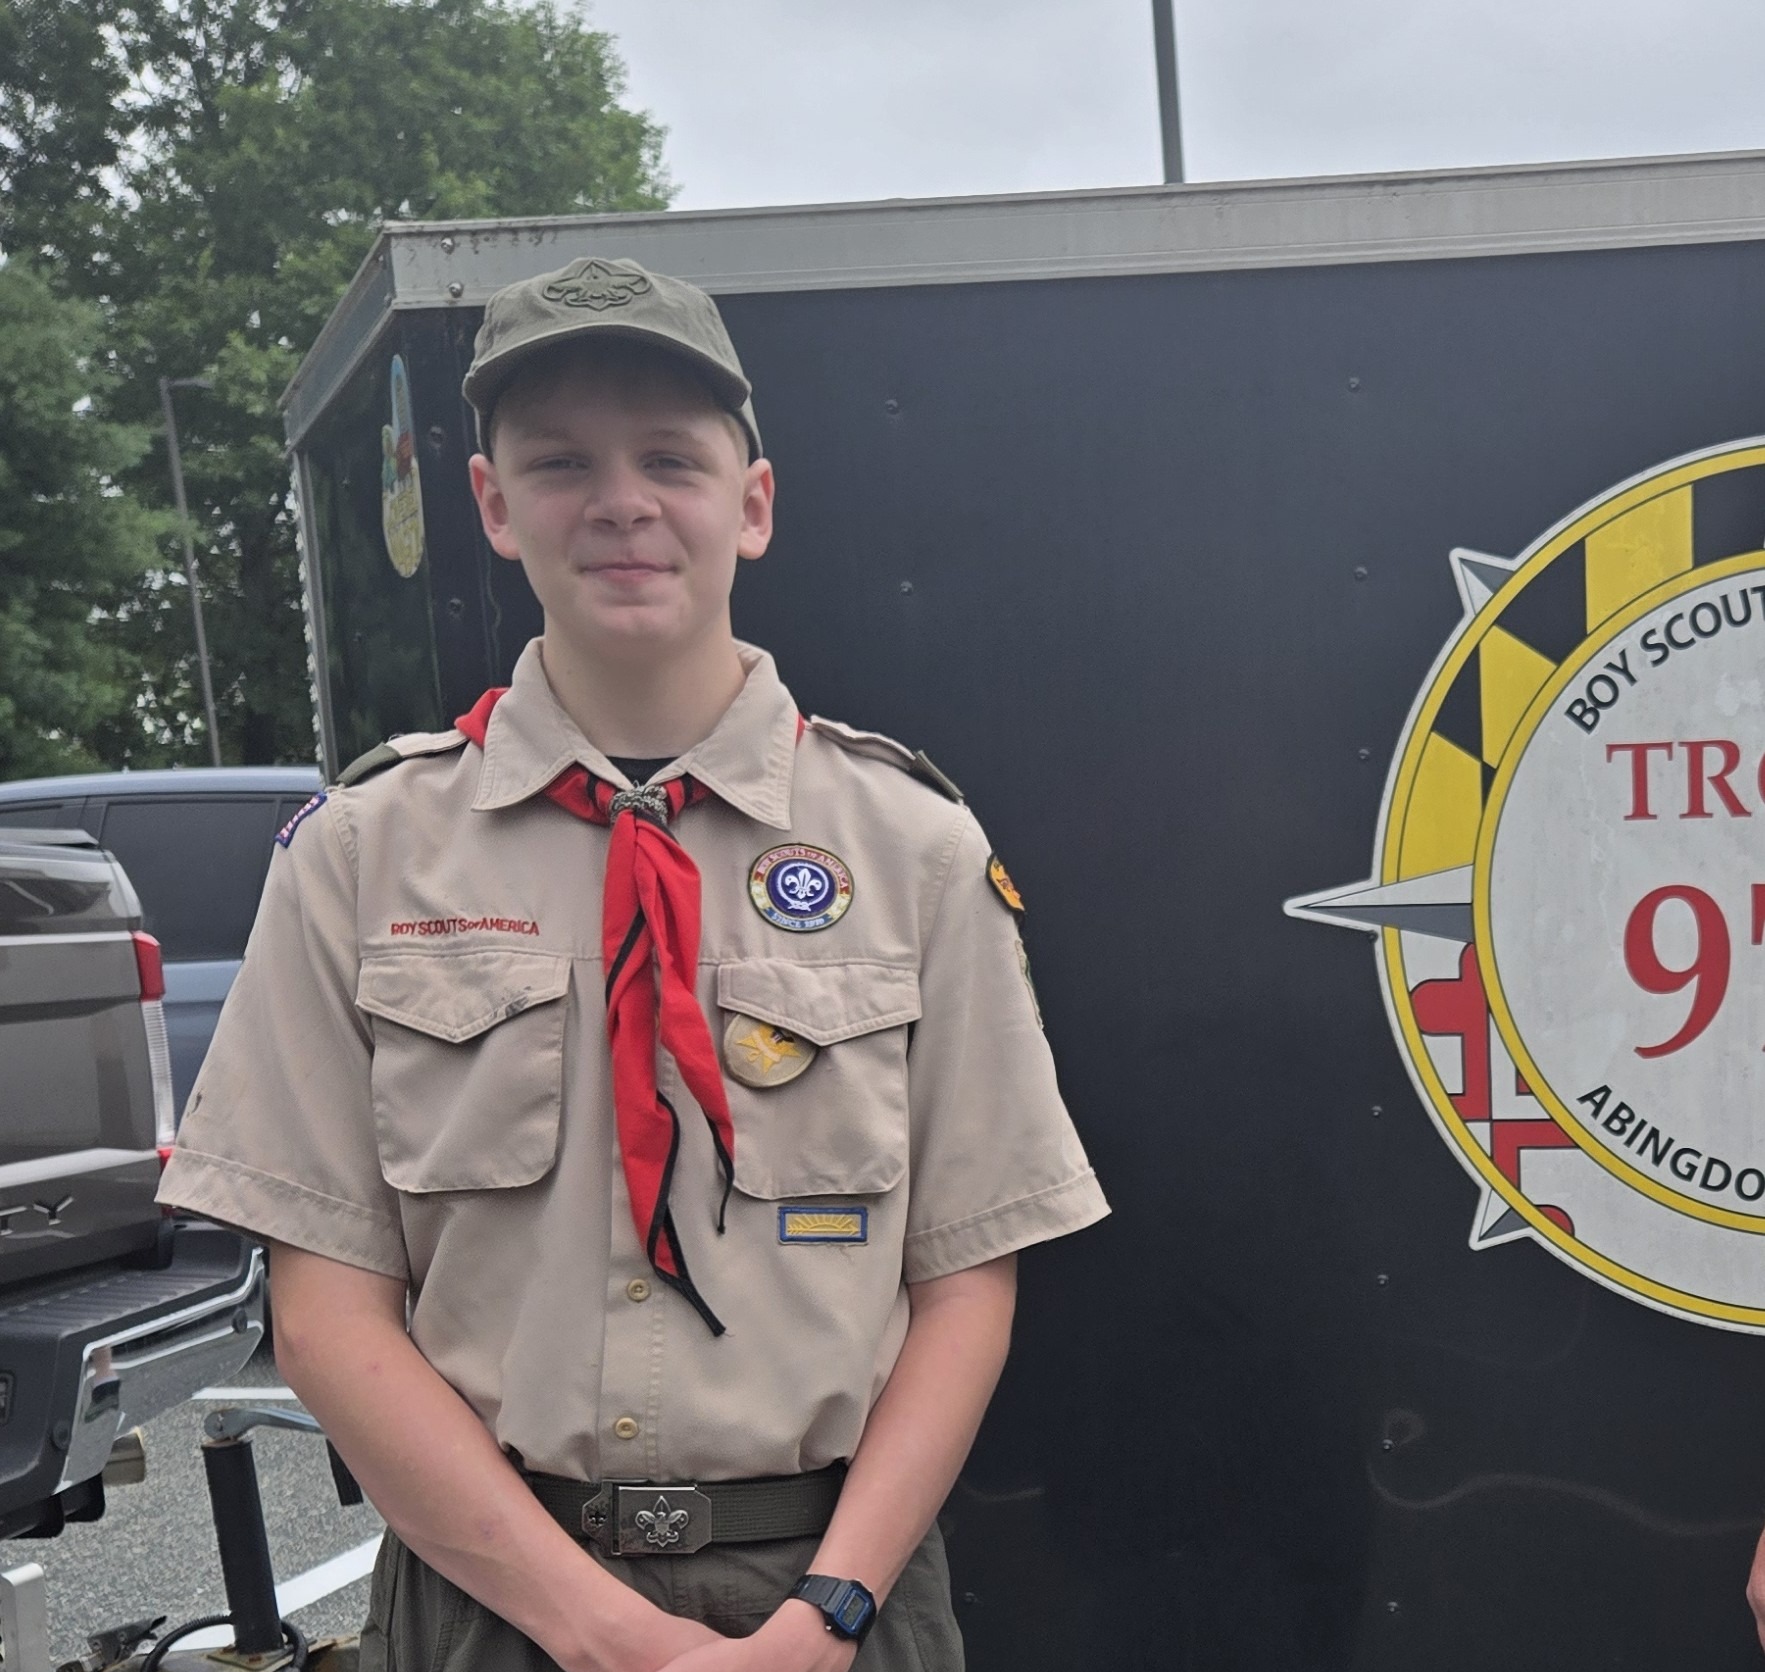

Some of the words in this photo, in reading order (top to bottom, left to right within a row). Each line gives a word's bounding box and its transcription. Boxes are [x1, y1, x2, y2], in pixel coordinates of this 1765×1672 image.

[1564, 649, 1638, 735] BOY
[1606, 739, 1765, 821] TR
[390, 922, 417, 936] BOY
[417, 918, 468, 936] SCOUTS
[478, 917, 540, 937] AMERICA
[1623, 883, 1765, 1059] 9
[1576, 1084, 1765, 1202] ABINGDO
